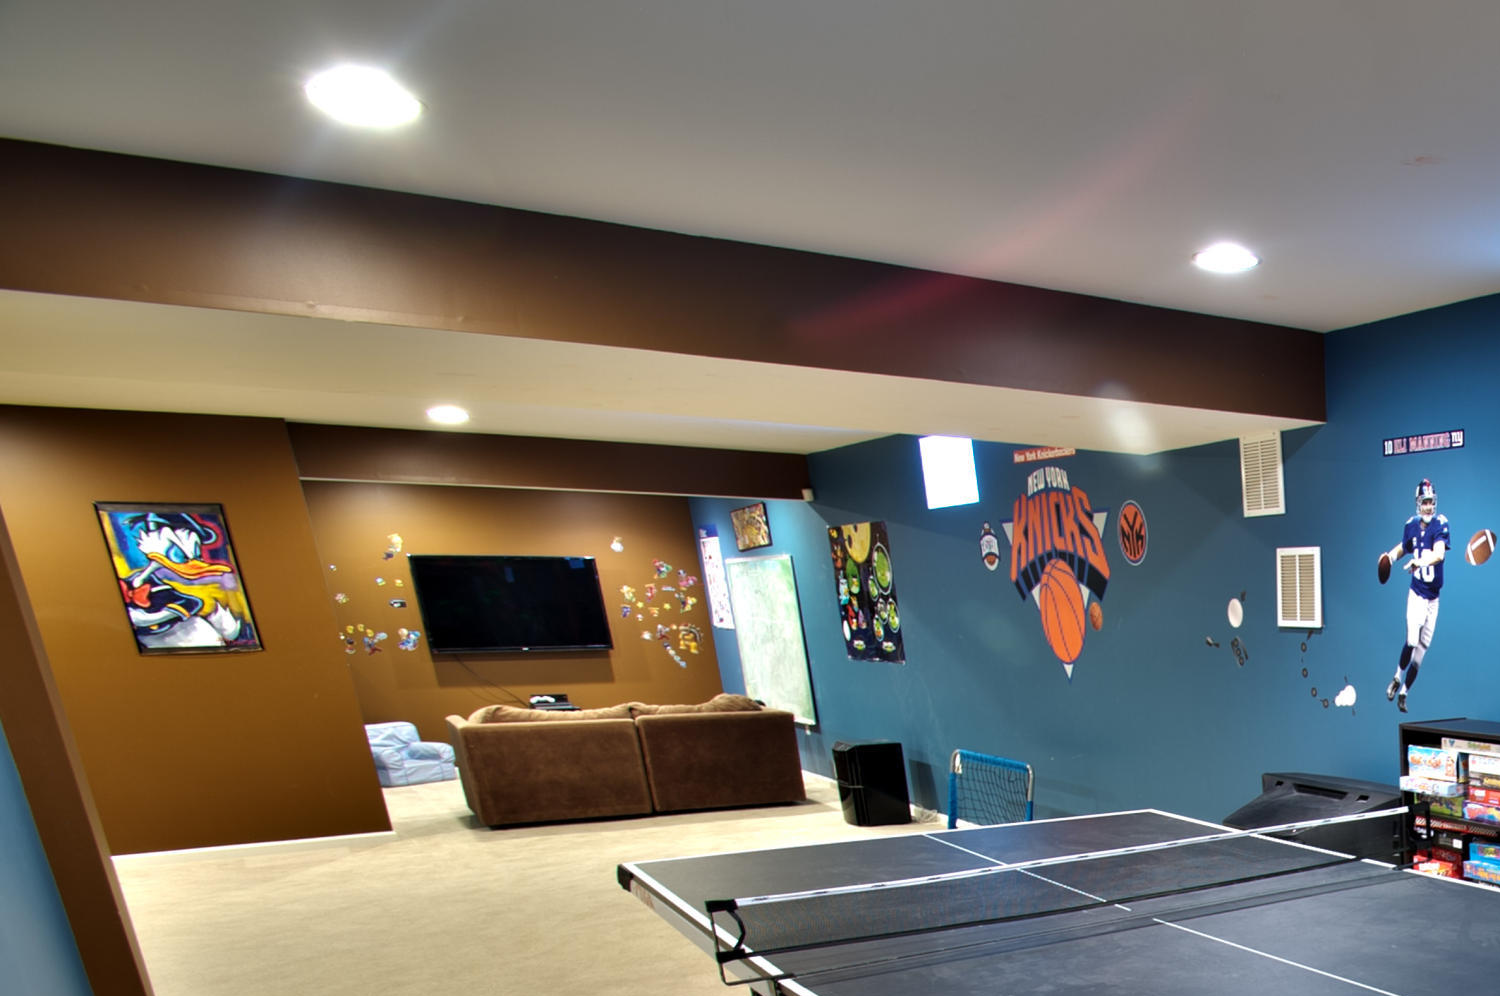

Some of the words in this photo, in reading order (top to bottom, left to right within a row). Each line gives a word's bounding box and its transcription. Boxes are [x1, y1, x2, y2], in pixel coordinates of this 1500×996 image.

[1384, 440, 1393, 455] 10
[1027, 468, 1045, 497] NEW
[1045, 466, 1071, 491] YORK
[1010, 486, 1110, 583] KNICKS
